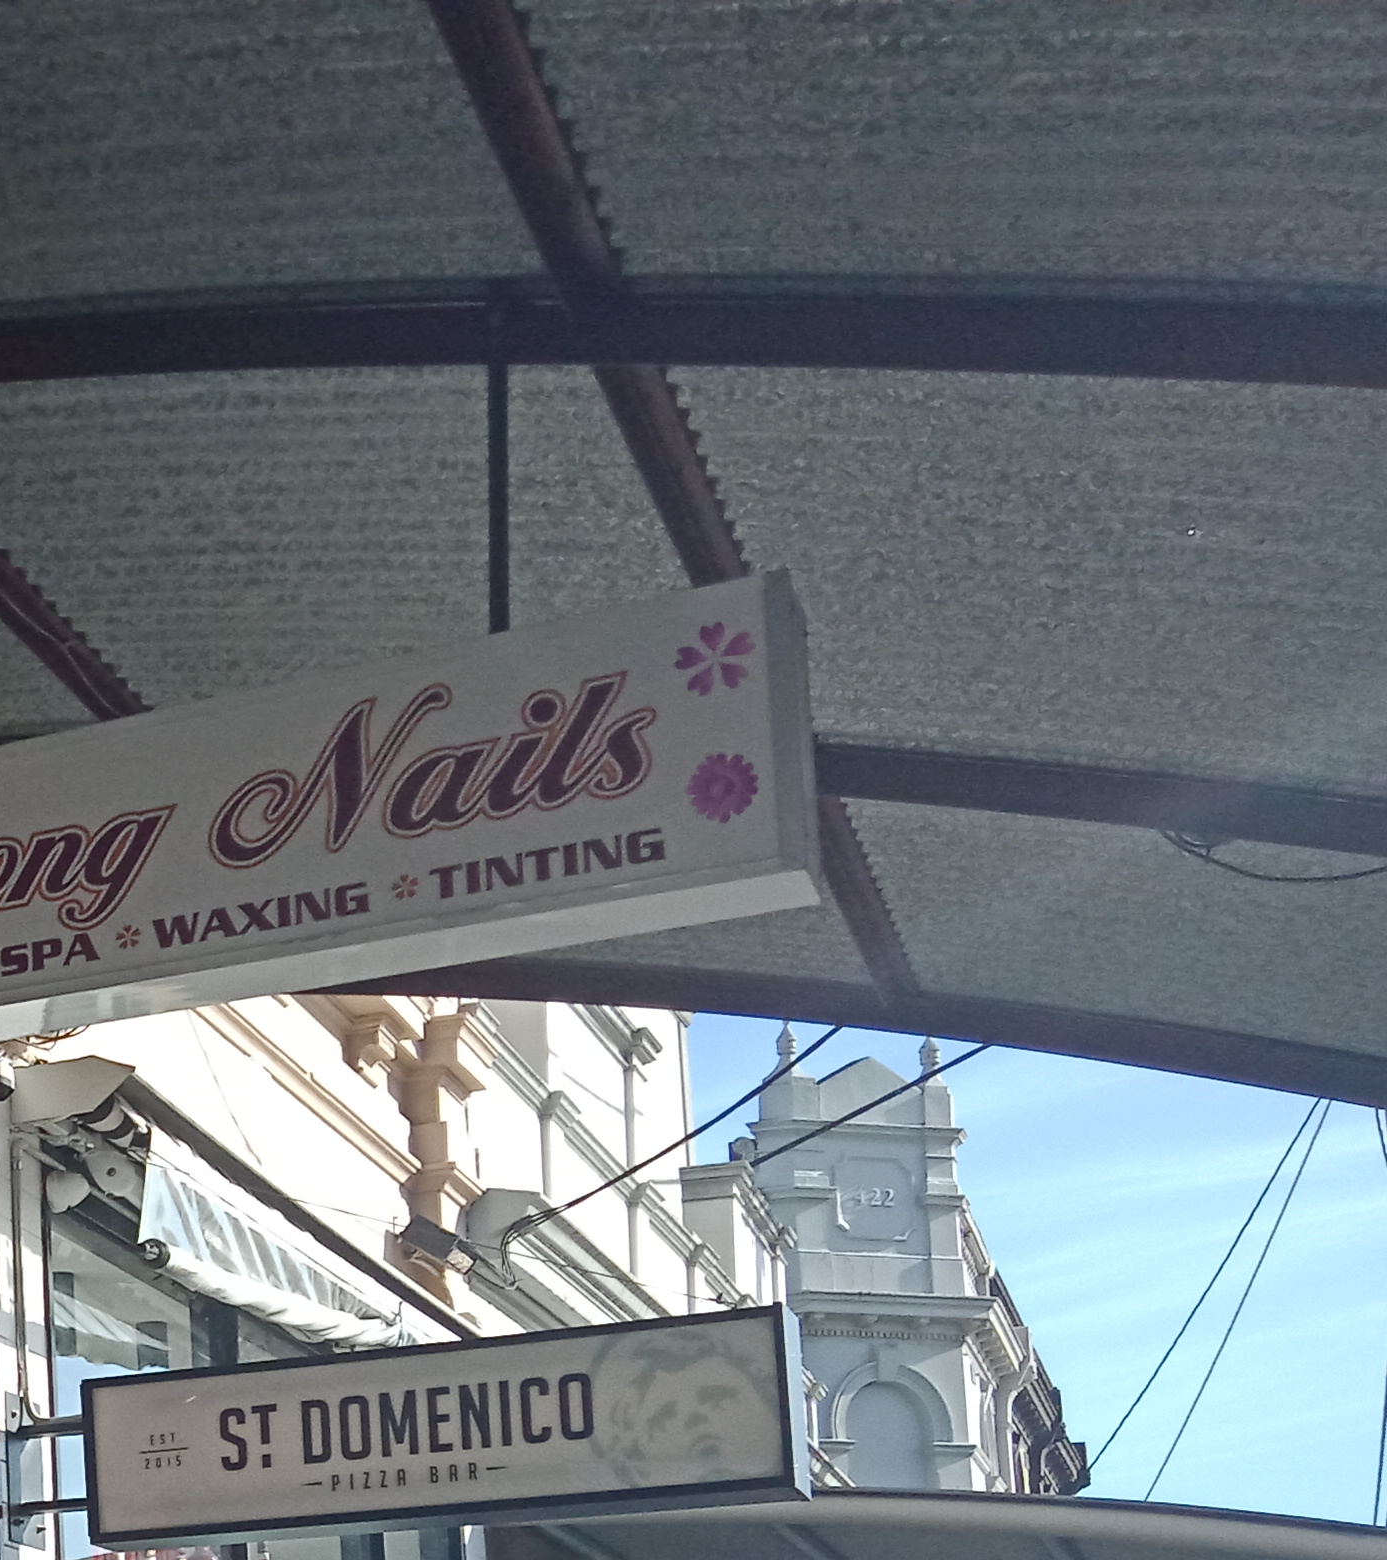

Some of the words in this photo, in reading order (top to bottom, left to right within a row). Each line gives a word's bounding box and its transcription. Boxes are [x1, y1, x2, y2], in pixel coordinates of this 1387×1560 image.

[209, 671, 656, 867] Nails
[0, 930, 100, 976] SPA
[153, 880, 371, 950] WAXING
[430, 829, 668, 899] TINTING
[144, 1456, 183, 1469] 2015
[302, 1372, 594, 1465] DOMENICO
[331, 1468, 408, 1492] PIZZA
[430, 1463, 479, 1484] BAR
